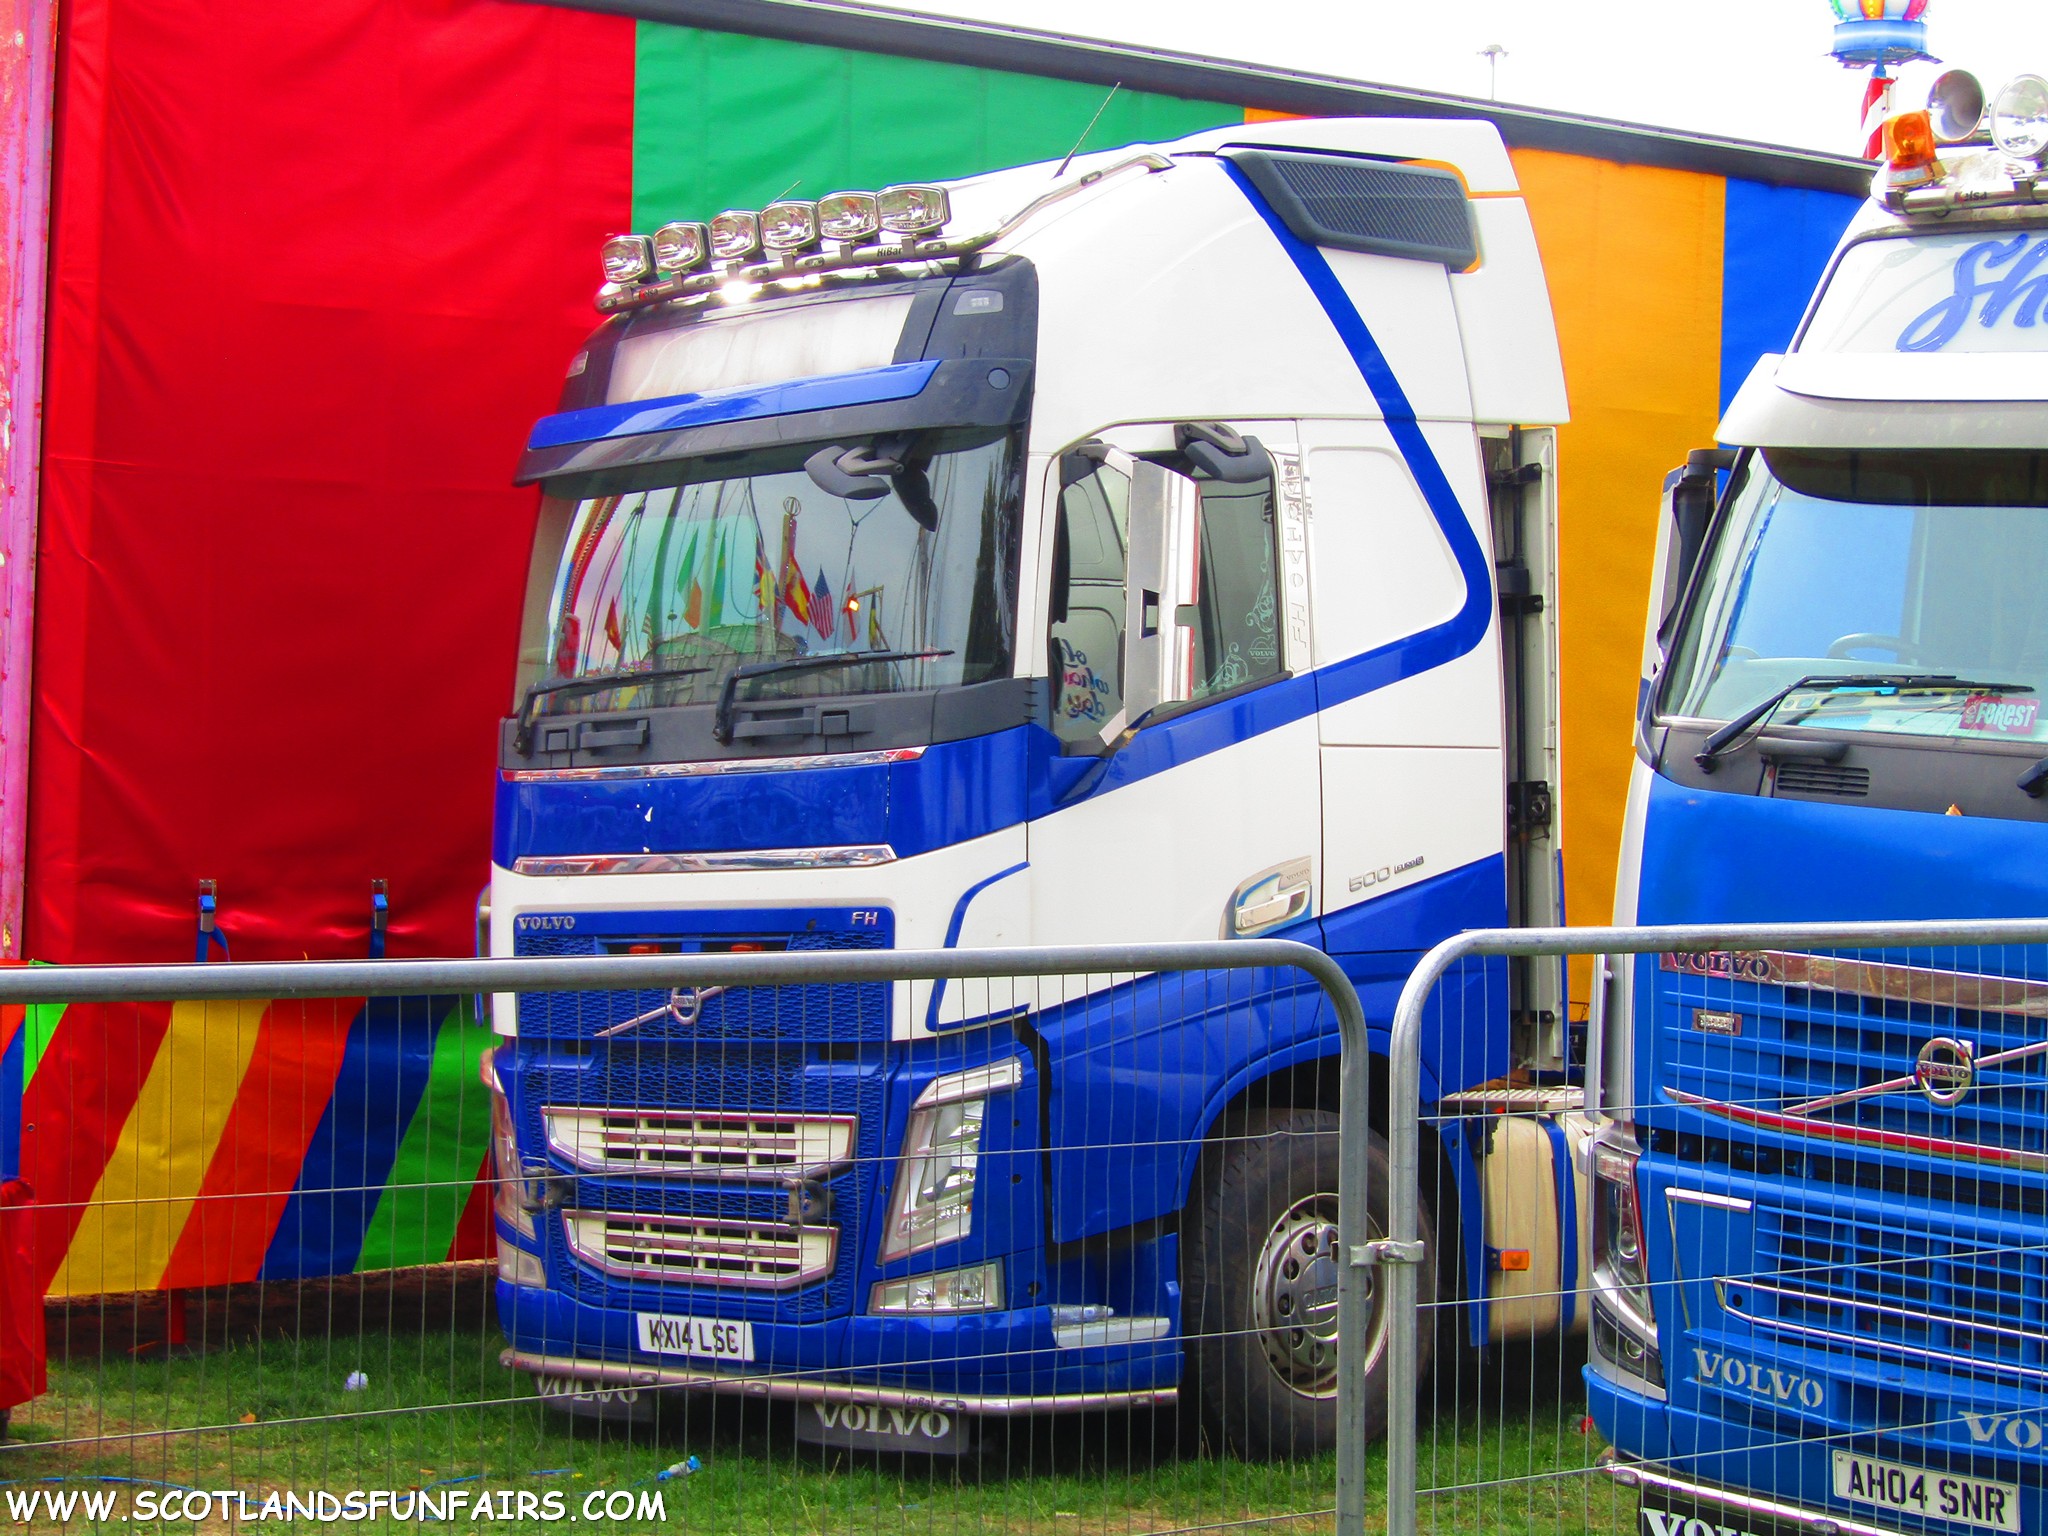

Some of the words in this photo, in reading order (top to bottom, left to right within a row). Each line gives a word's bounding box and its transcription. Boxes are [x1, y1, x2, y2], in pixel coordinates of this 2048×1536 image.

[1896, 233, 2048, 352] Sh
[1349, 867, 1390, 892] 500
[517, 916, 575, 930] VOLVO
[851, 911, 878, 925] FH
[1670, 951, 1772, 980] VOLVO
[1920, 1063, 1969, 1079] VOLVO
[648, 1319, 693, 1350] KX14
[698, 1323, 739, 1354] LSC
[1692, 1348, 1824, 1408] VOLVO
[813, 1401, 951, 1438] VOLVO
[1958, 1411, 2048, 1452] VO
[1848, 1460, 1928, 1509] AH04
[1938, 1478, 2005, 1524] SNR
